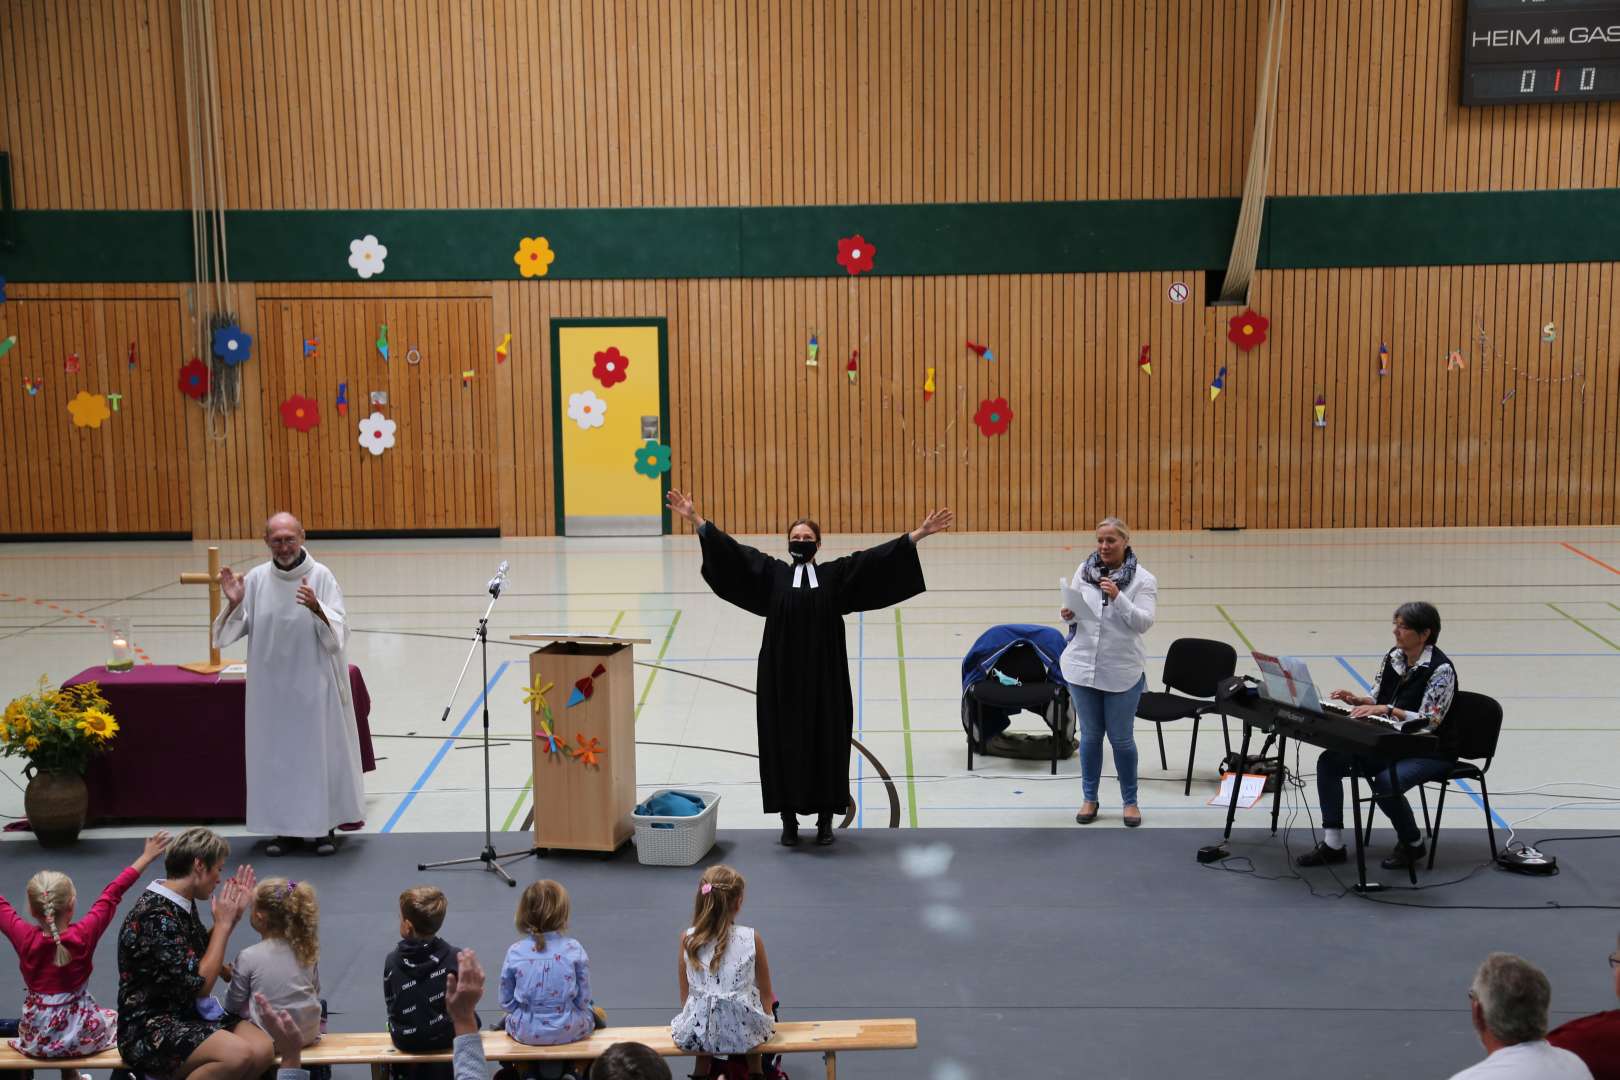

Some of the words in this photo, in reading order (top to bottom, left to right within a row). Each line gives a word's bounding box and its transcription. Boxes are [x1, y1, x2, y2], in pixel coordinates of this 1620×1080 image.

[1472, 29, 1540, 47] HEIM
[1520, 70, 1536, 92] 0
[1580, 67, 1596, 90] 0
